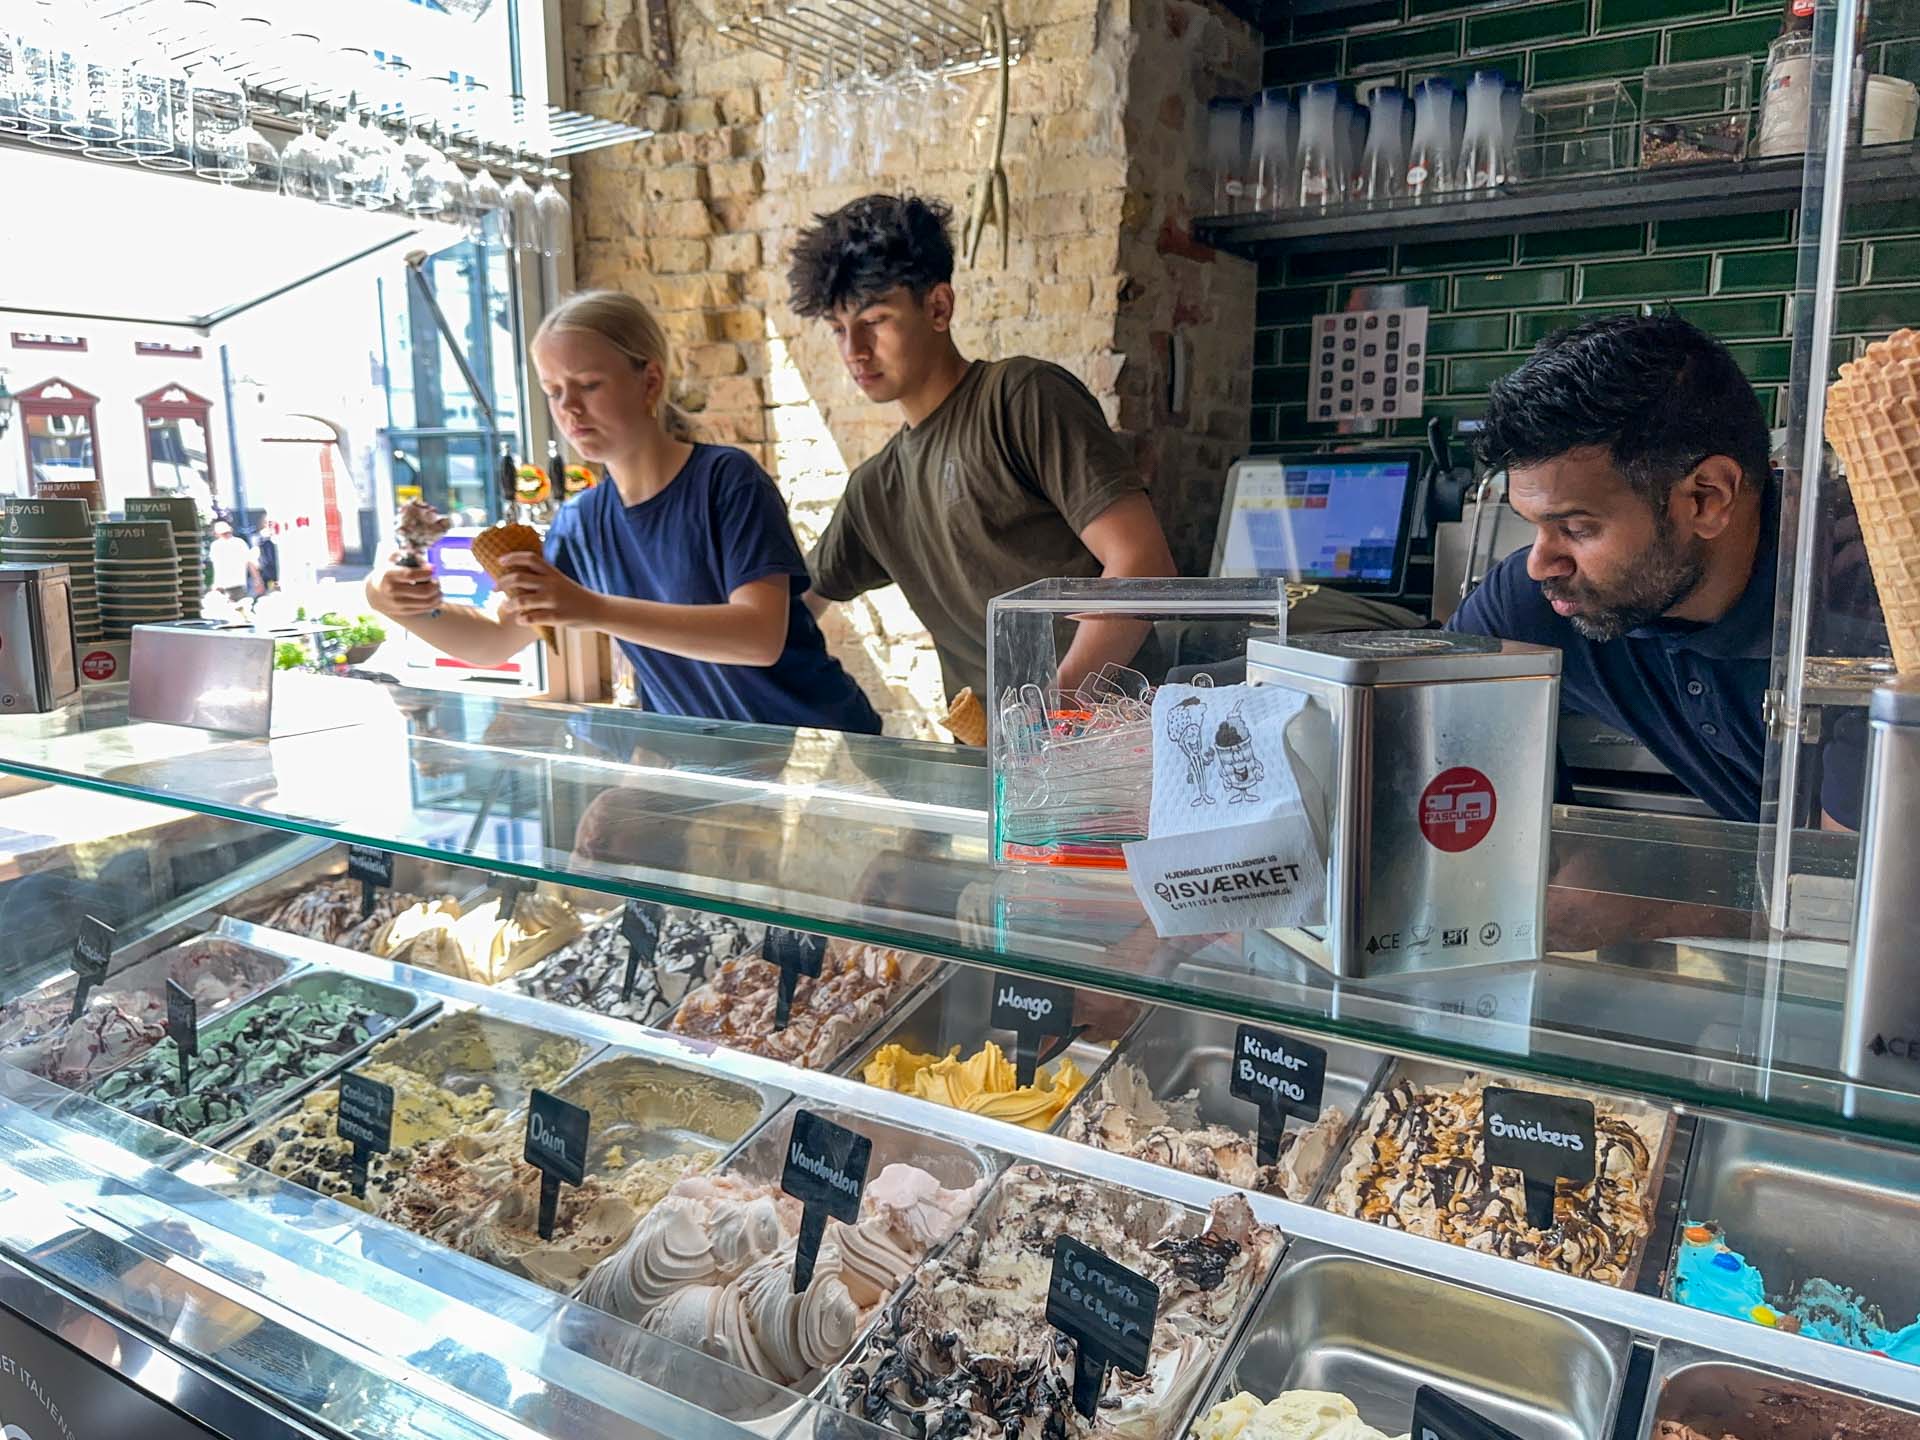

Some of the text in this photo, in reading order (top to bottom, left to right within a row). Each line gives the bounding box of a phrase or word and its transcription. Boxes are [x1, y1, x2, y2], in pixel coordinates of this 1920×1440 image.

[1426, 810, 1482, 824] PASCUCCI
[1165, 864, 1223, 880] HJEMMELAVET
[1225, 856, 1268, 871] ITALIENSK
[1169, 864, 1300, 899] ISVÆRKET
[998, 986, 1052, 1020] Mango
[1243, 1035, 1308, 1071] Kinder
[1240, 1059, 1305, 1100] Bueno
[531, 1112, 566, 1158] Daim
[1489, 1113, 1584, 1151] Snickers
[791, 1142, 858, 1197] Vandmelon
[0, 1354, 16, 1375] ET
